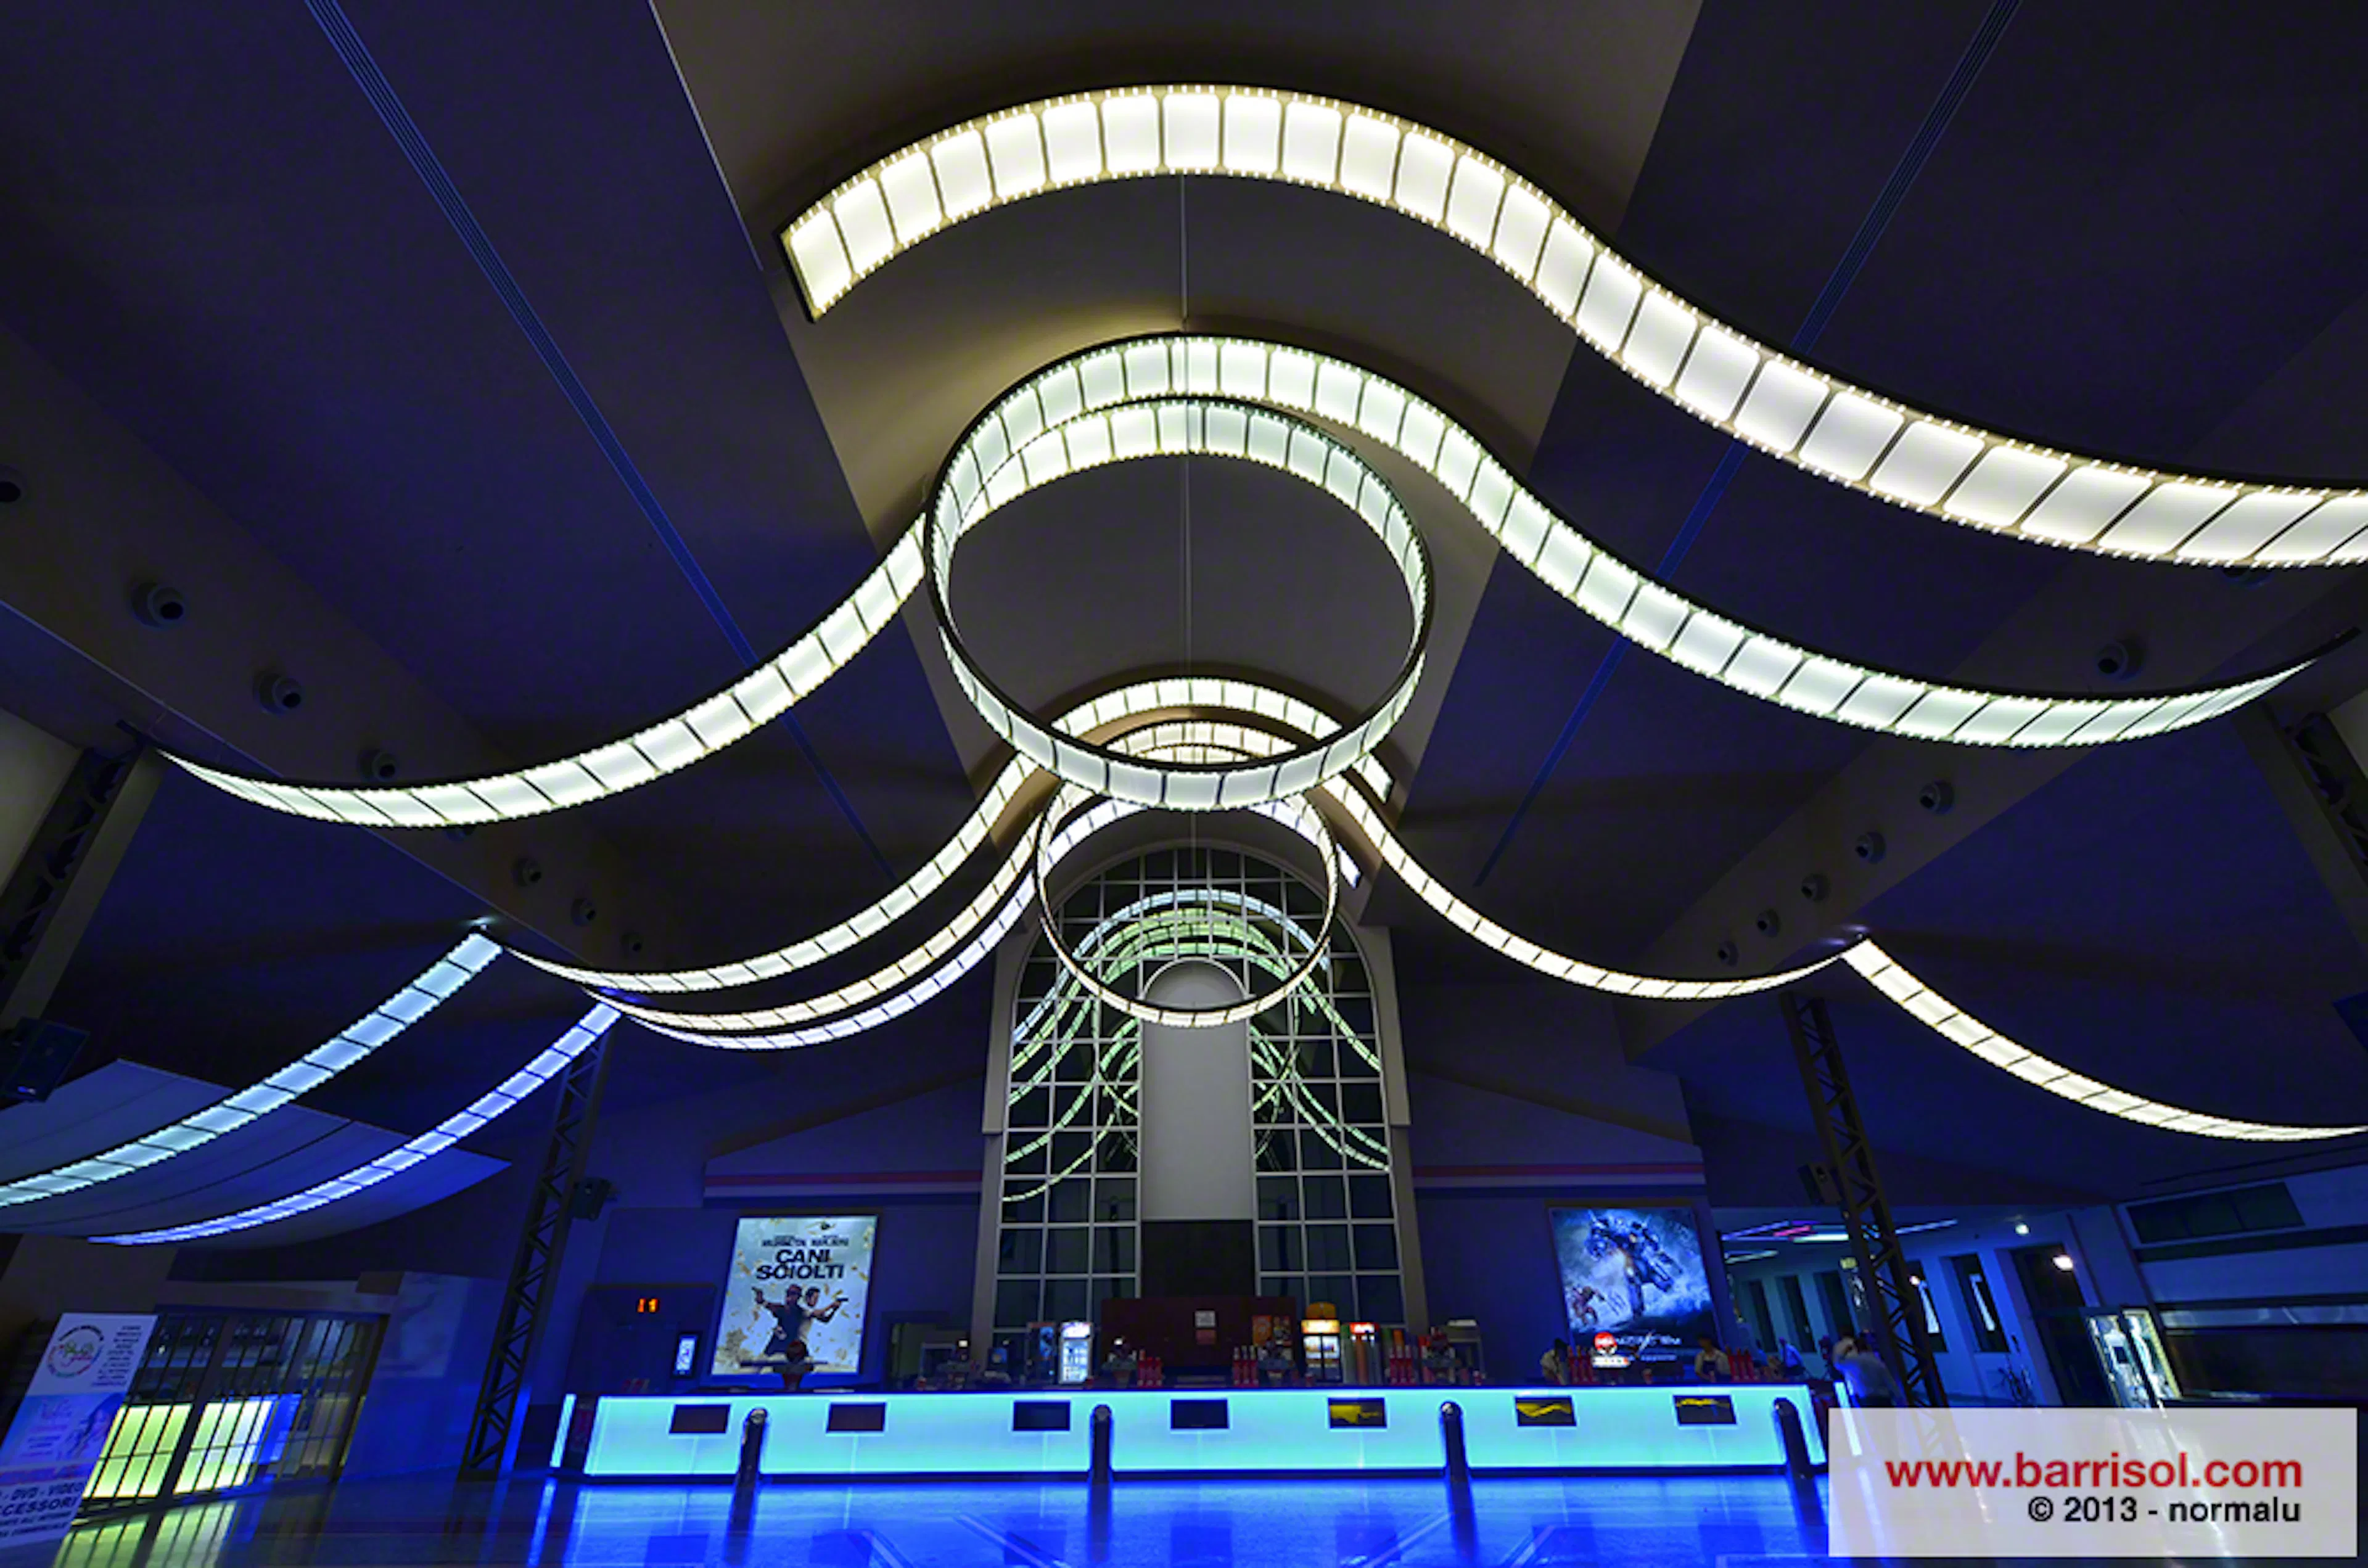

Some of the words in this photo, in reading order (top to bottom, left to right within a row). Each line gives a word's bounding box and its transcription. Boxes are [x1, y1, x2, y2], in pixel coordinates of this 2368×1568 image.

[776, 1249, 830, 1263] CANI
[756, 1264, 844, 1279] SCIOLTI
[0, 1496, 78, 1517] CESSORI
